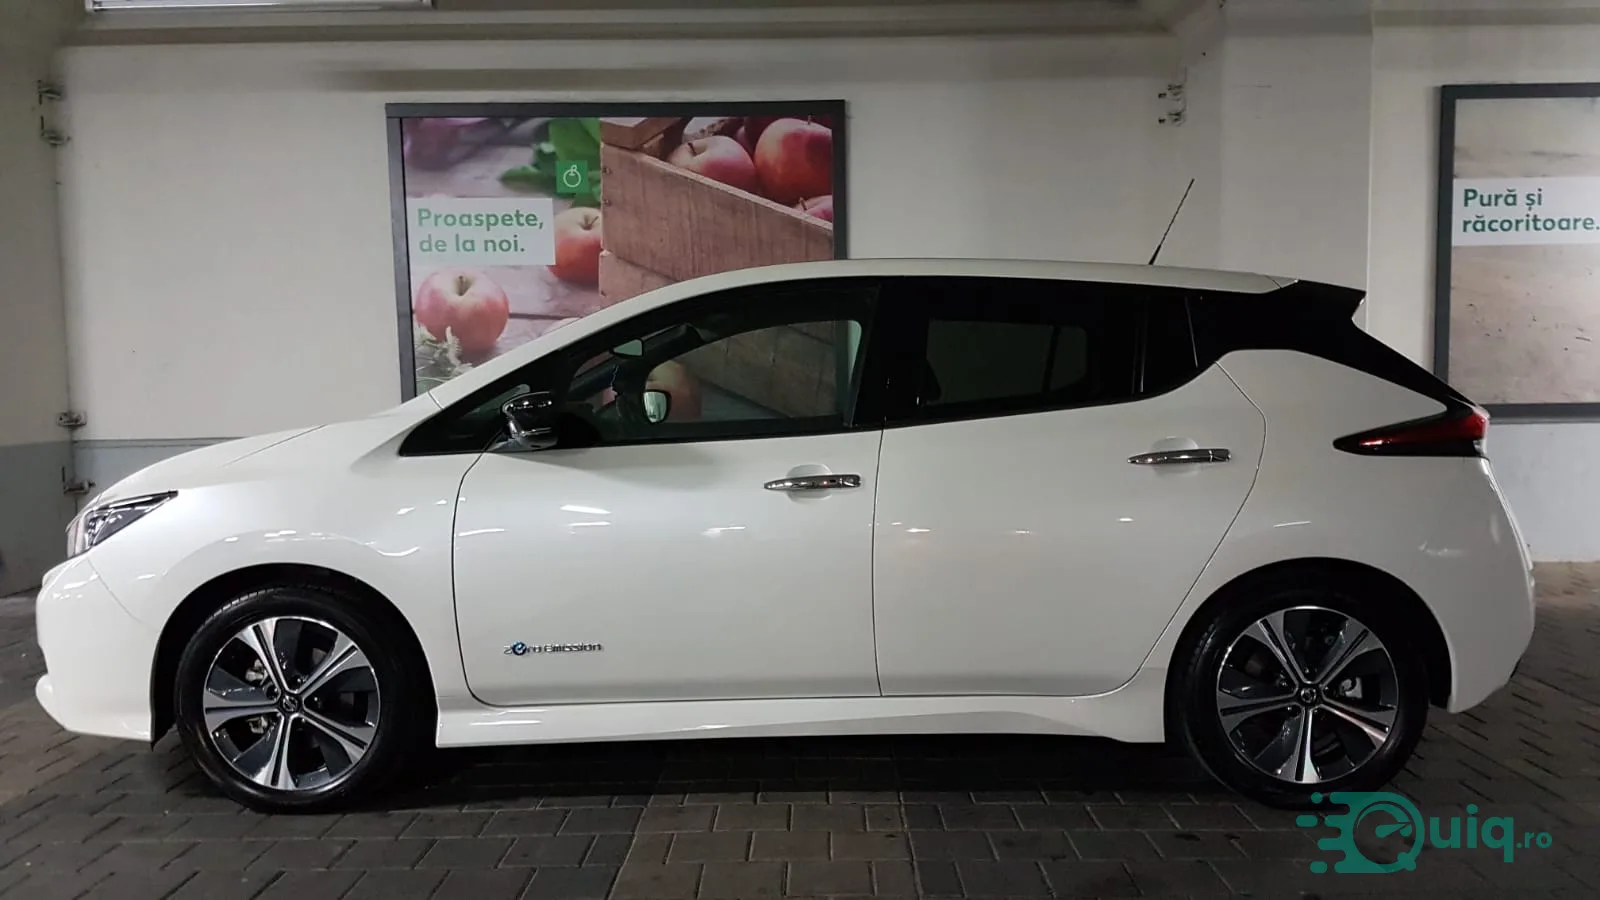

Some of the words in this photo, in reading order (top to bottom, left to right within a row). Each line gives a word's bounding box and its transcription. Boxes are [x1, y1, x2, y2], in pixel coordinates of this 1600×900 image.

[1463, 188, 1517, 208] Pură
[1525, 188, 1543, 211] și
[417, 208, 544, 231] Proaspete,
[1462, 214, 1600, 232] răcoritoare.
[419, 234, 447, 252] de
[455, 234, 476, 252] la
[484, 234, 525, 252] noi.
